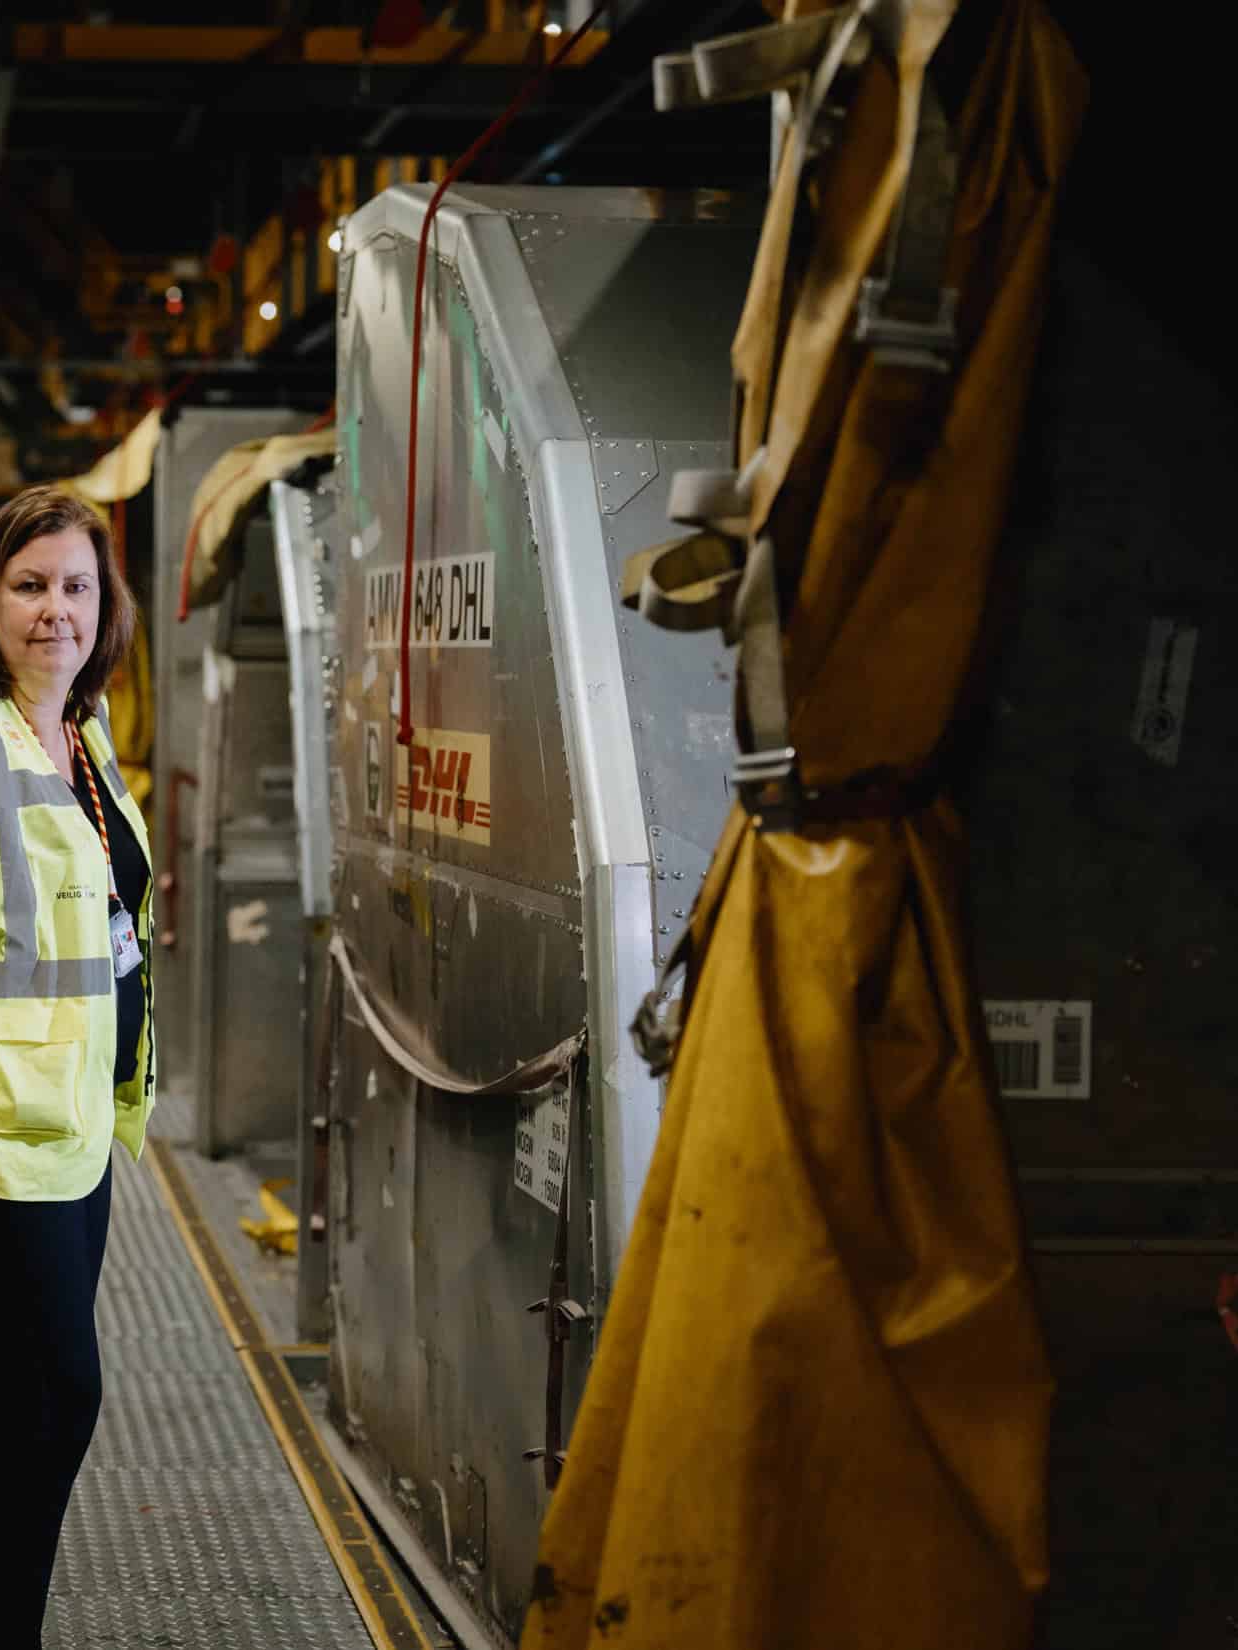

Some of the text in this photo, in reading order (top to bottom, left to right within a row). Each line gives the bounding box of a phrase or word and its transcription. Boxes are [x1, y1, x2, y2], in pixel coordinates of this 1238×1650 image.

[414, 567, 444, 641] 648
[448, 560, 491, 641] DHL
[408, 745, 476, 825] DHL
